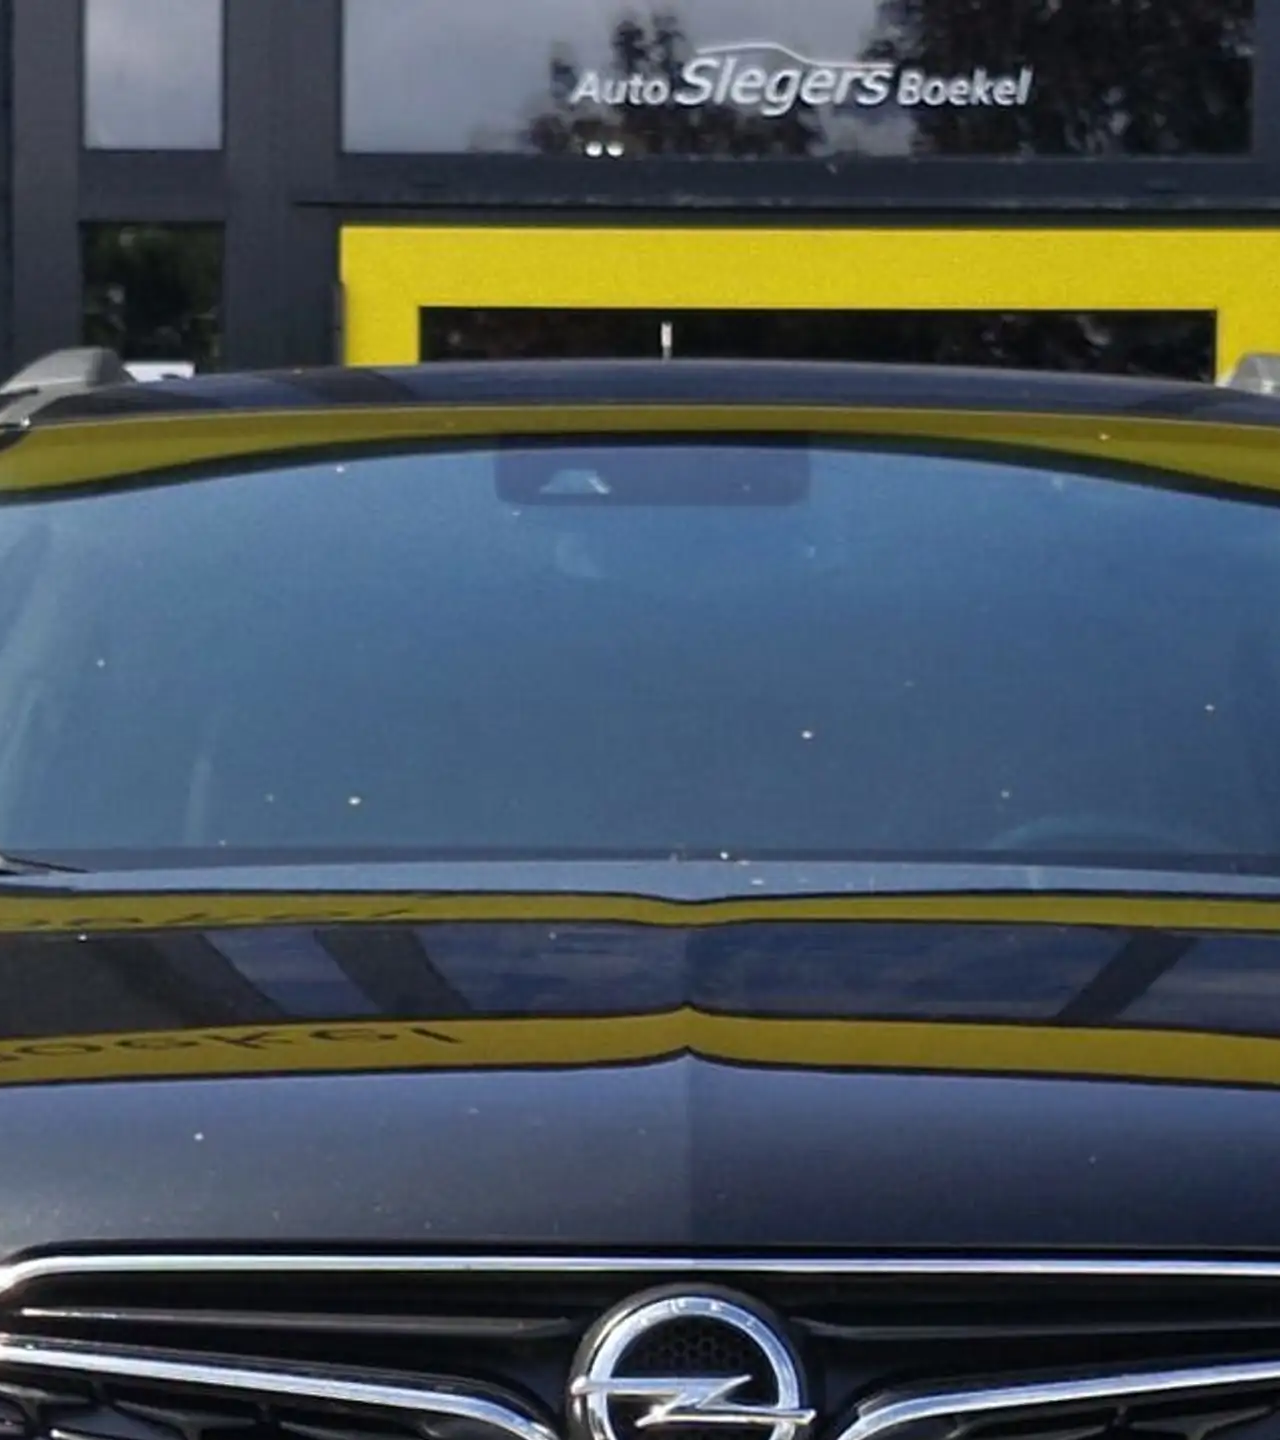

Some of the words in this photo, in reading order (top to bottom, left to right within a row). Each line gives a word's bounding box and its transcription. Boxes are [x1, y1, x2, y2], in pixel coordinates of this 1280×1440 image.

[570, 71, 668, 105] Auto
[675, 57, 893, 116] Slegers
[897, 67, 1033, 106] Boekel
